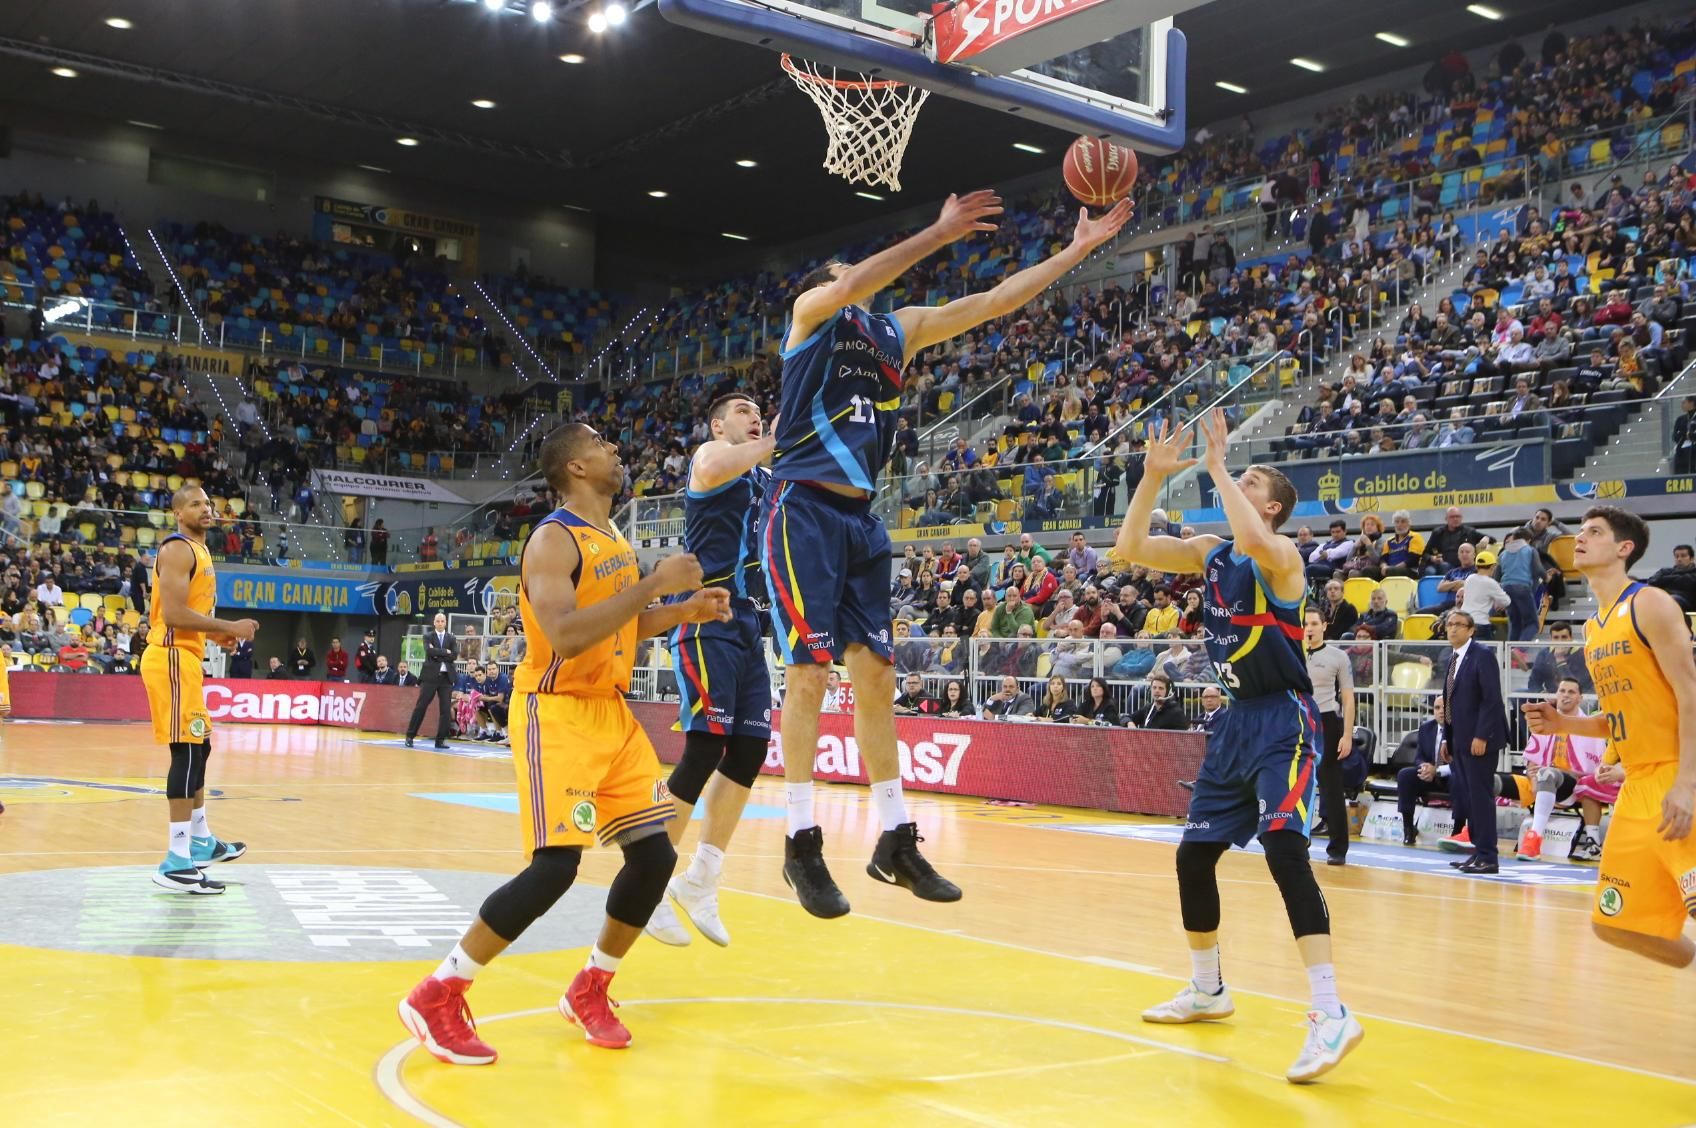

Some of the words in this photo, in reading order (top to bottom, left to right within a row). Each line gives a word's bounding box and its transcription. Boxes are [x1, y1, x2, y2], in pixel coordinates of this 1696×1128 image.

[320, 473, 426, 491] HALCOURIER
[1353, 472, 1421, 495] Cabildo
[1424, 470, 1447, 489] de
[1666, 478, 1694, 493] GRAN
[1433, 493, 1455, 507] GRAN
[1458, 491, 1494, 505] CANARIA
[1042, 520, 1057, 531] GRAN
[1058, 519, 1082, 530] CANARIA
[233, 579, 276, 603] GRAN
[282, 582, 349, 607] CANARIA
[202, 684, 367, 724] Canarias7
[1264, 811, 1293, 821] TELECOM
